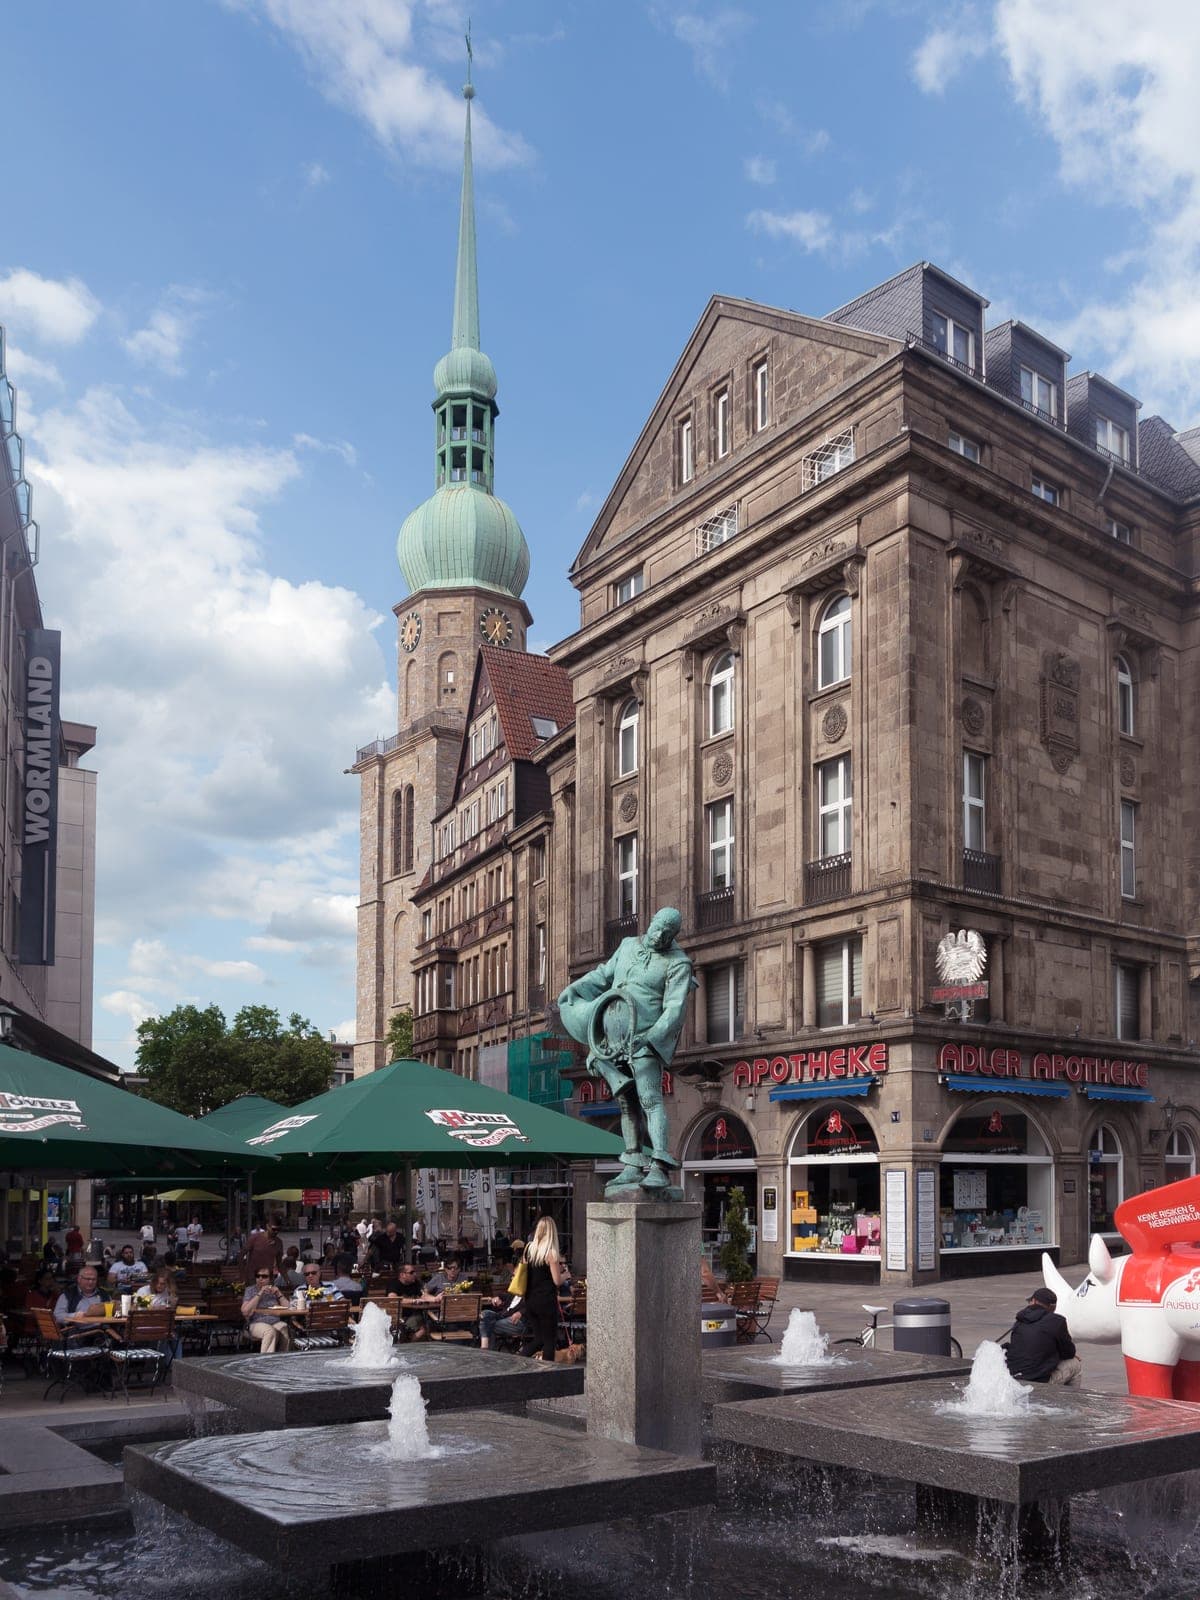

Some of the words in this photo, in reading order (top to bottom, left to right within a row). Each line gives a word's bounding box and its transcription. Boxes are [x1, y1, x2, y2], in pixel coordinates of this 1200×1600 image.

[25, 656, 52, 845] WORMLAND
[733, 1043, 886, 1086] APOTHEKE
[938, 1043, 1022, 1077] ADLER
[1032, 1053, 1150, 1088] APOTHEKE
[2, 1115, 74, 1131] ORIGINAL
[440, 1111, 509, 1129] HÖVELS
[472, 1128, 514, 1146] ORIGINAL
[1137, 1211, 1159, 1223] KEINE
[1158, 1205, 1188, 1218] RISIKEN
[1187, 1204, 1196, 1213] &
